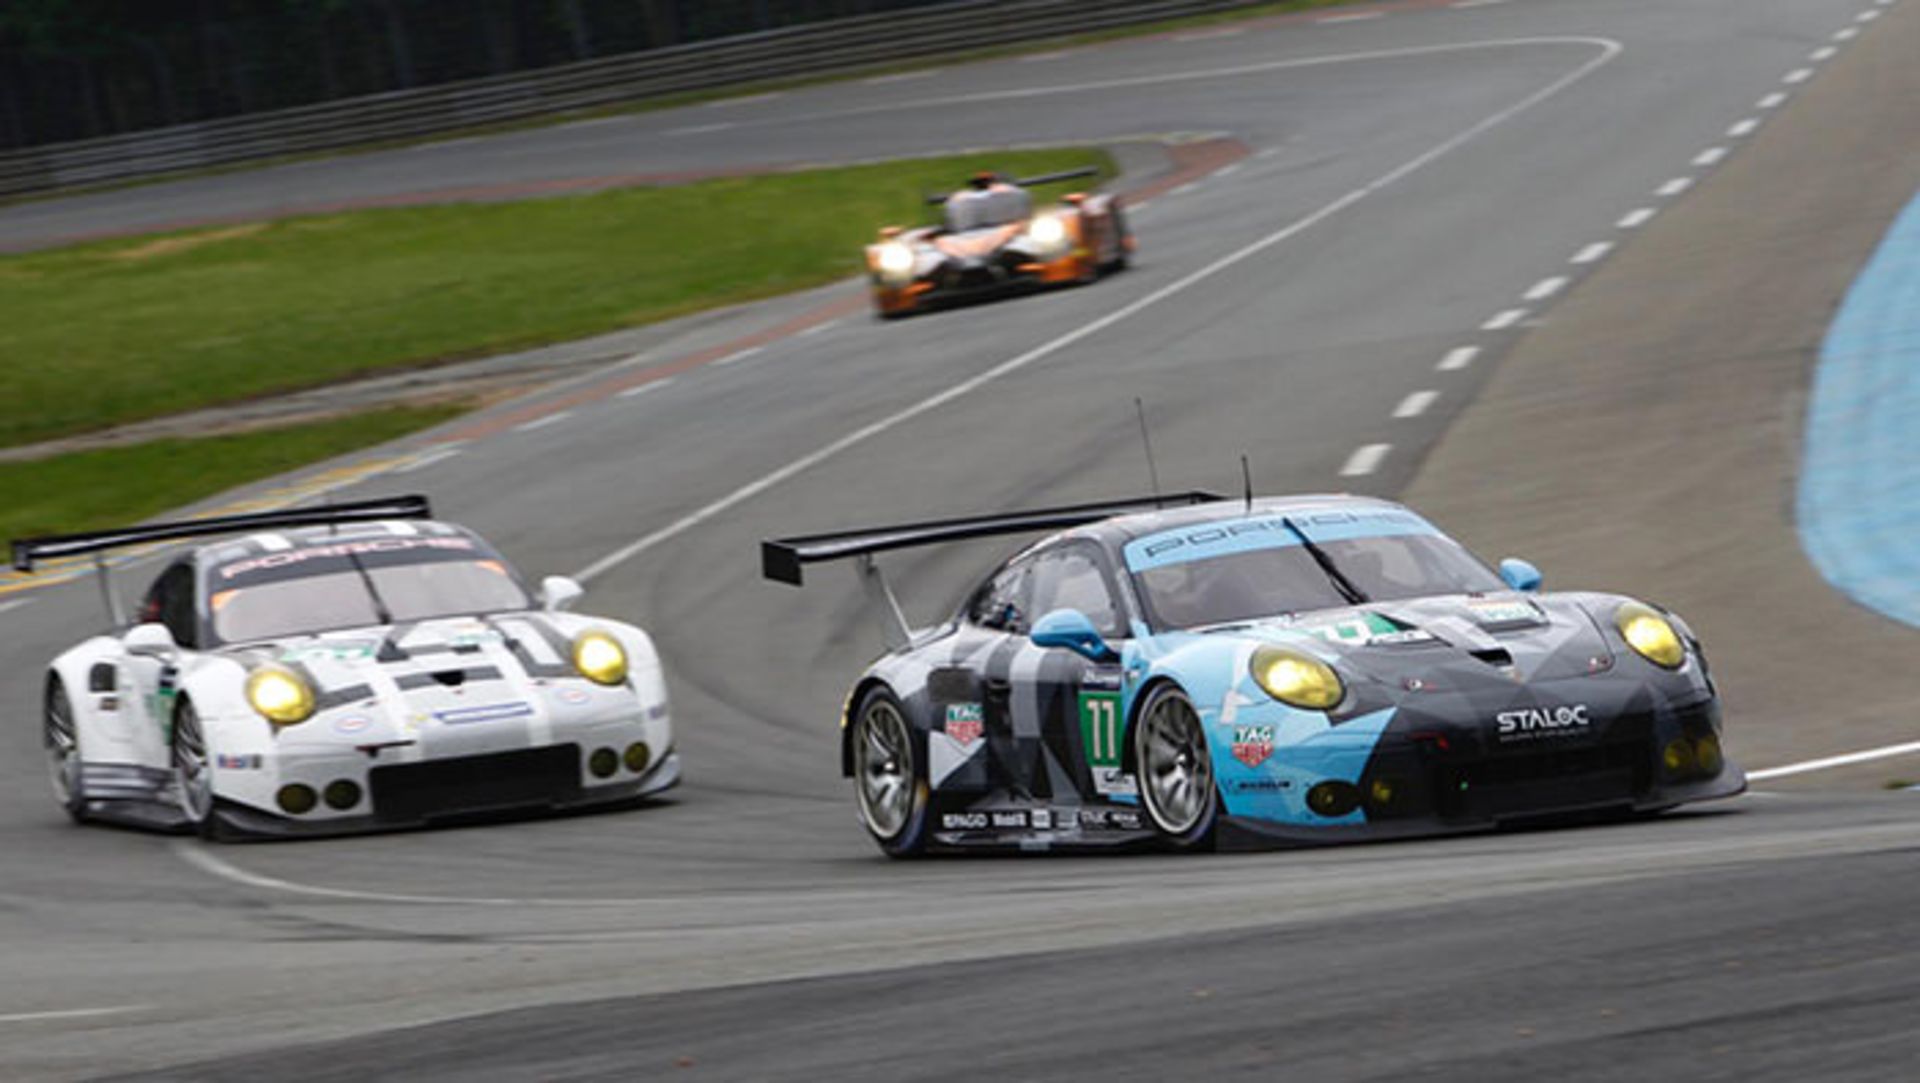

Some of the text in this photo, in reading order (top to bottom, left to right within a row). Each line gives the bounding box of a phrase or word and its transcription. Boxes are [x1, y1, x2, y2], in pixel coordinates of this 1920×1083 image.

[1145, 509, 1420, 557] PORSCHE
[1086, 699, 1116, 760] 11
[1233, 725, 1274, 743] TAG
[1496, 703, 1590, 733] STALOC
